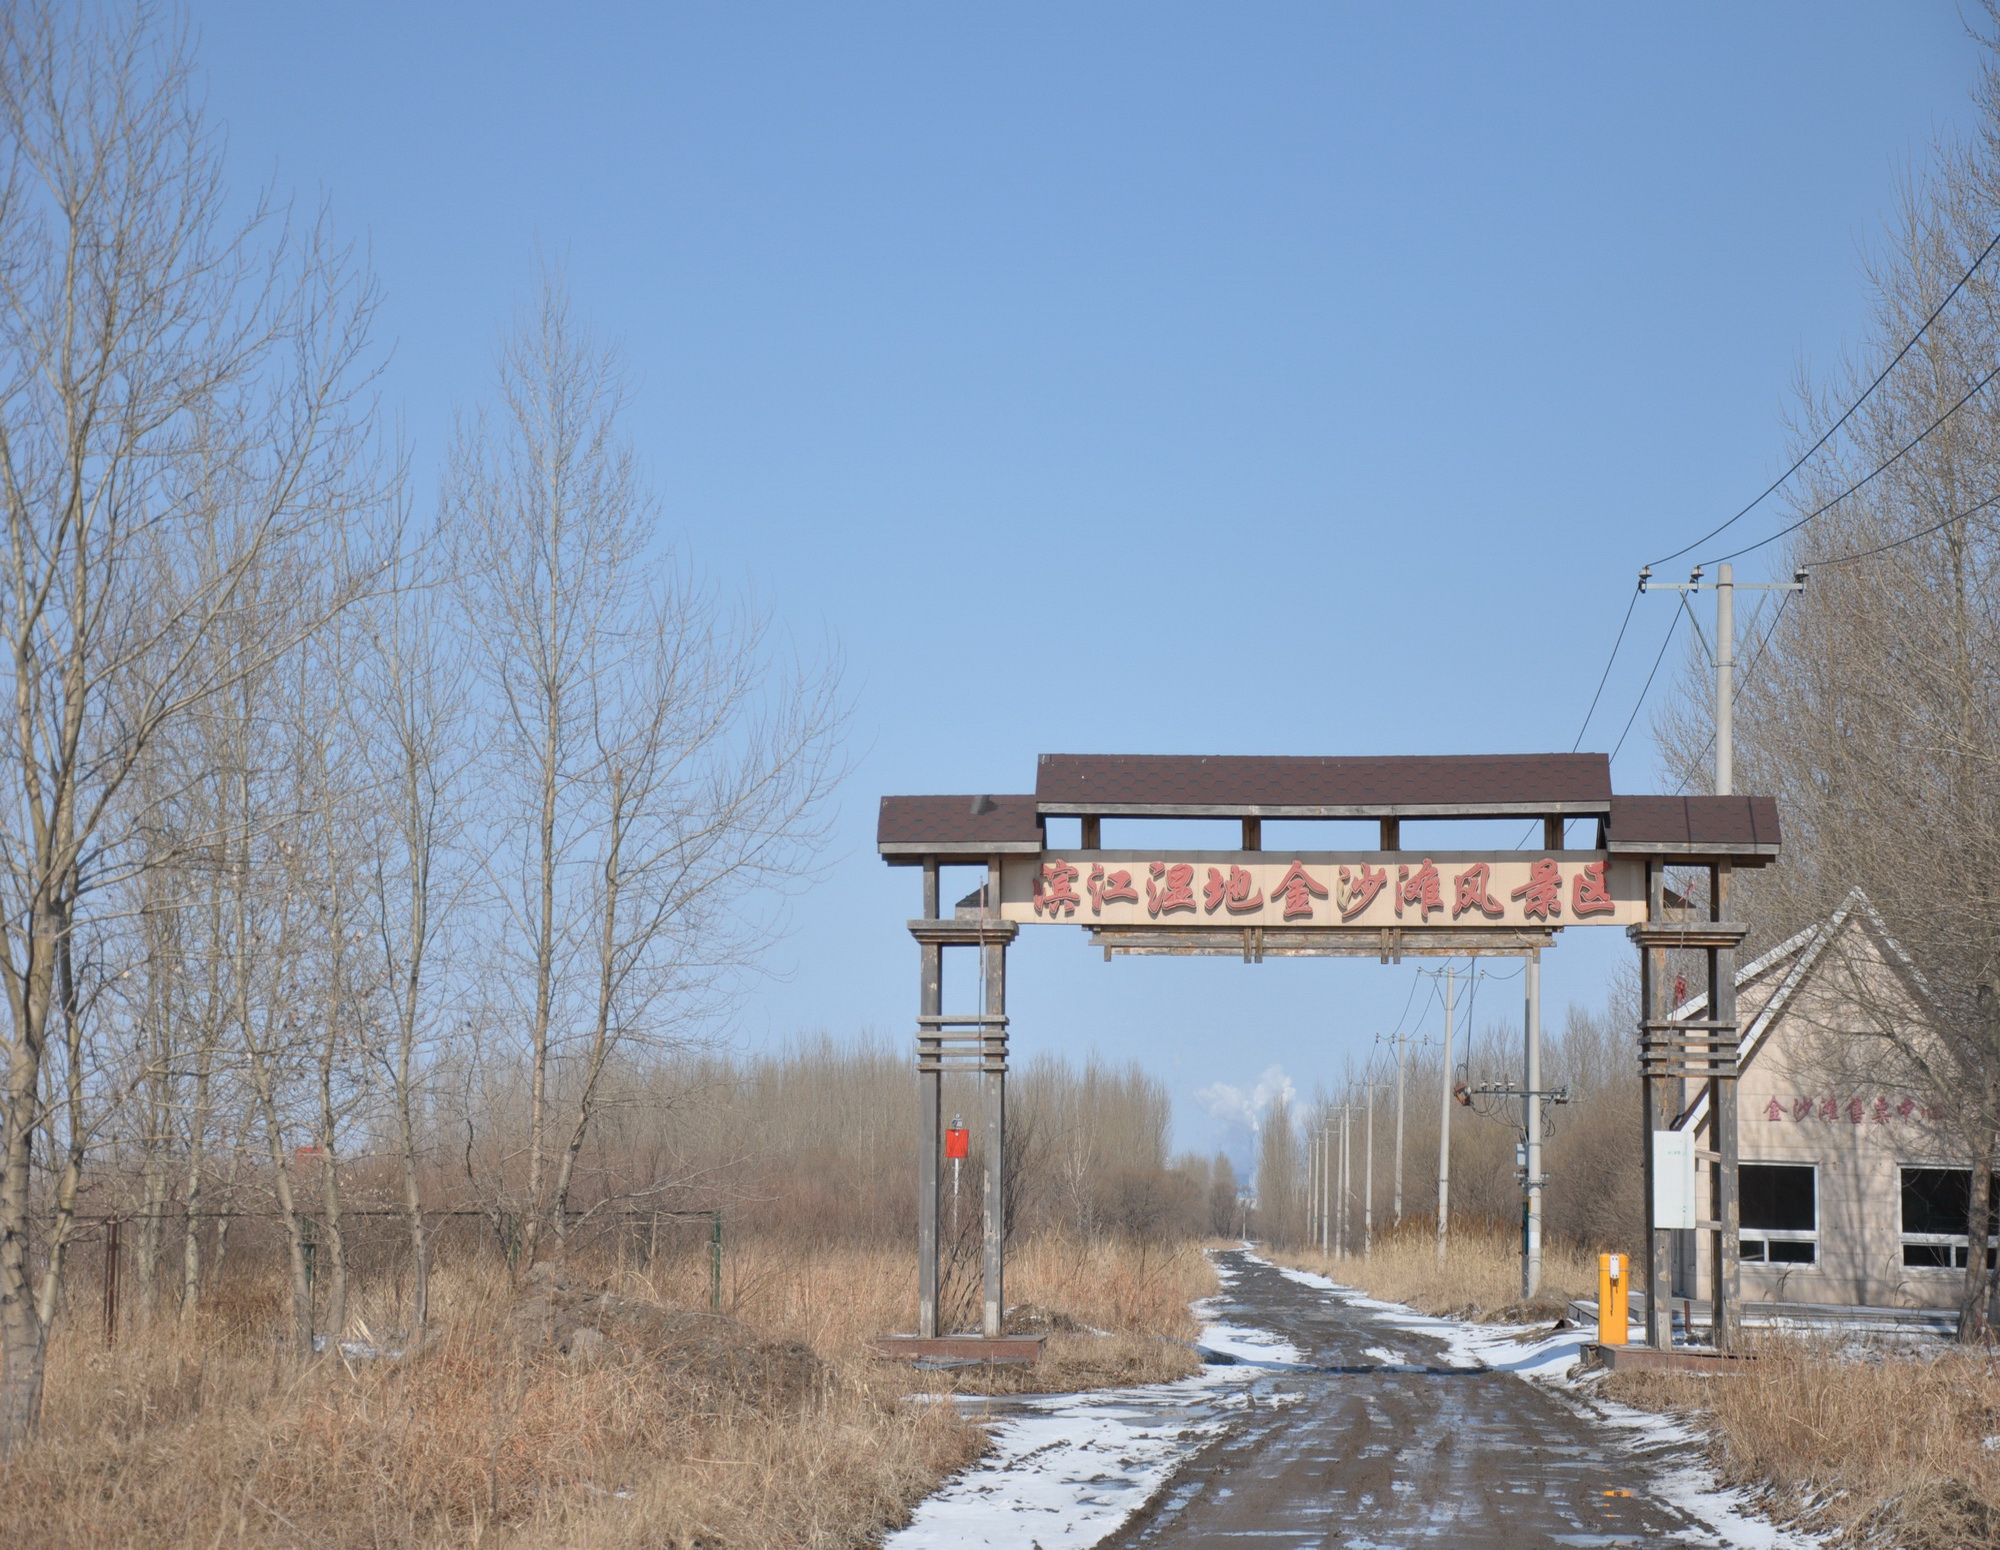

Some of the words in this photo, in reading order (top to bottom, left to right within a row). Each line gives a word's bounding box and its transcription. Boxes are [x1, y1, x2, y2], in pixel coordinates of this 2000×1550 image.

[1033, 858, 1615, 917] 滨江湿地金沙滩风景区
